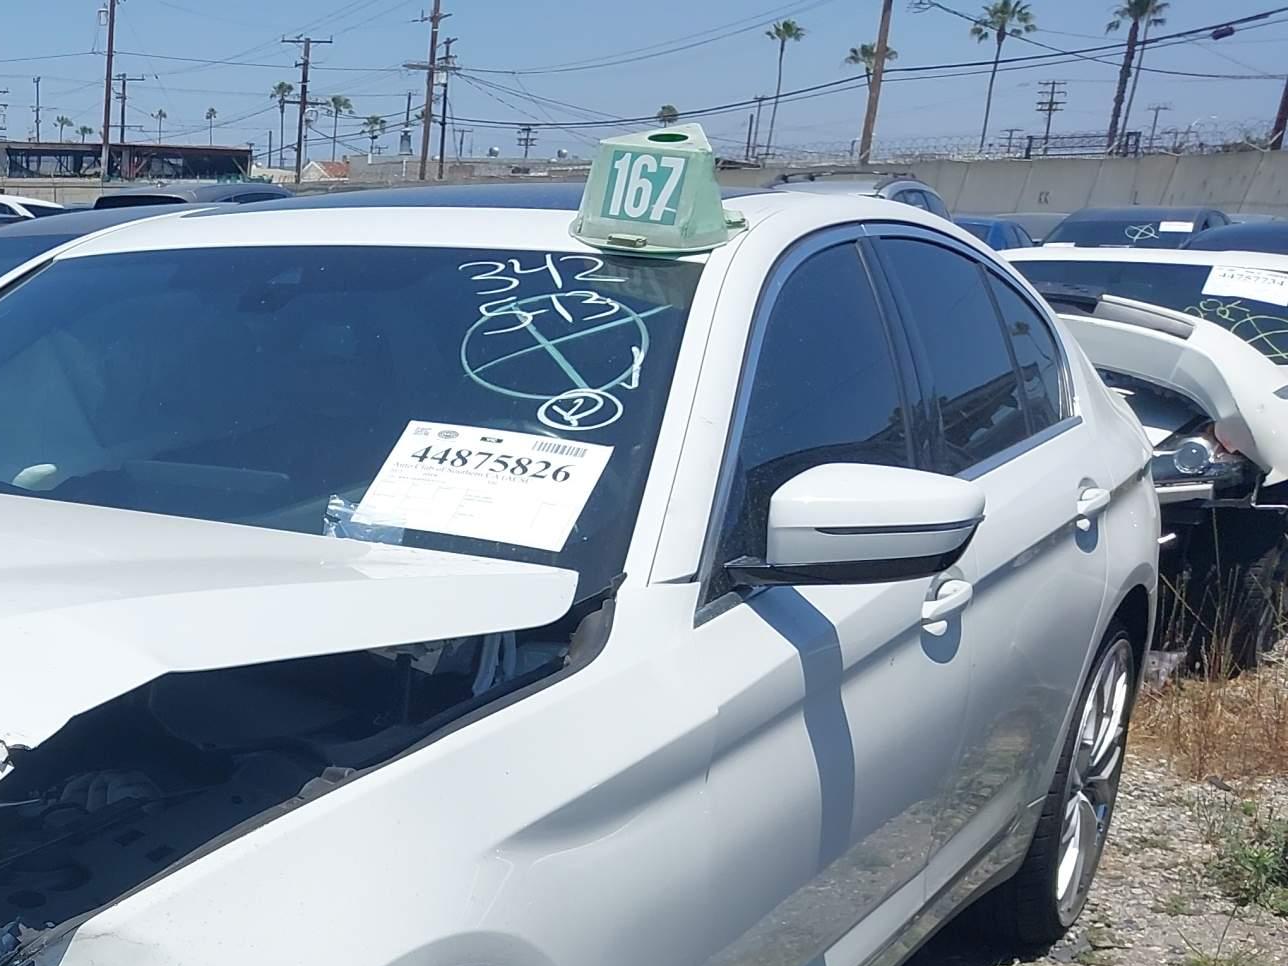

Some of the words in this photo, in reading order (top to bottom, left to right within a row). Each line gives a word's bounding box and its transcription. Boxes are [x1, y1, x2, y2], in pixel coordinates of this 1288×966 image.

[609, 153, 685, 221] 167
[458, 253, 629, 295] 342
[410, 445, 577, 483] 44875826
